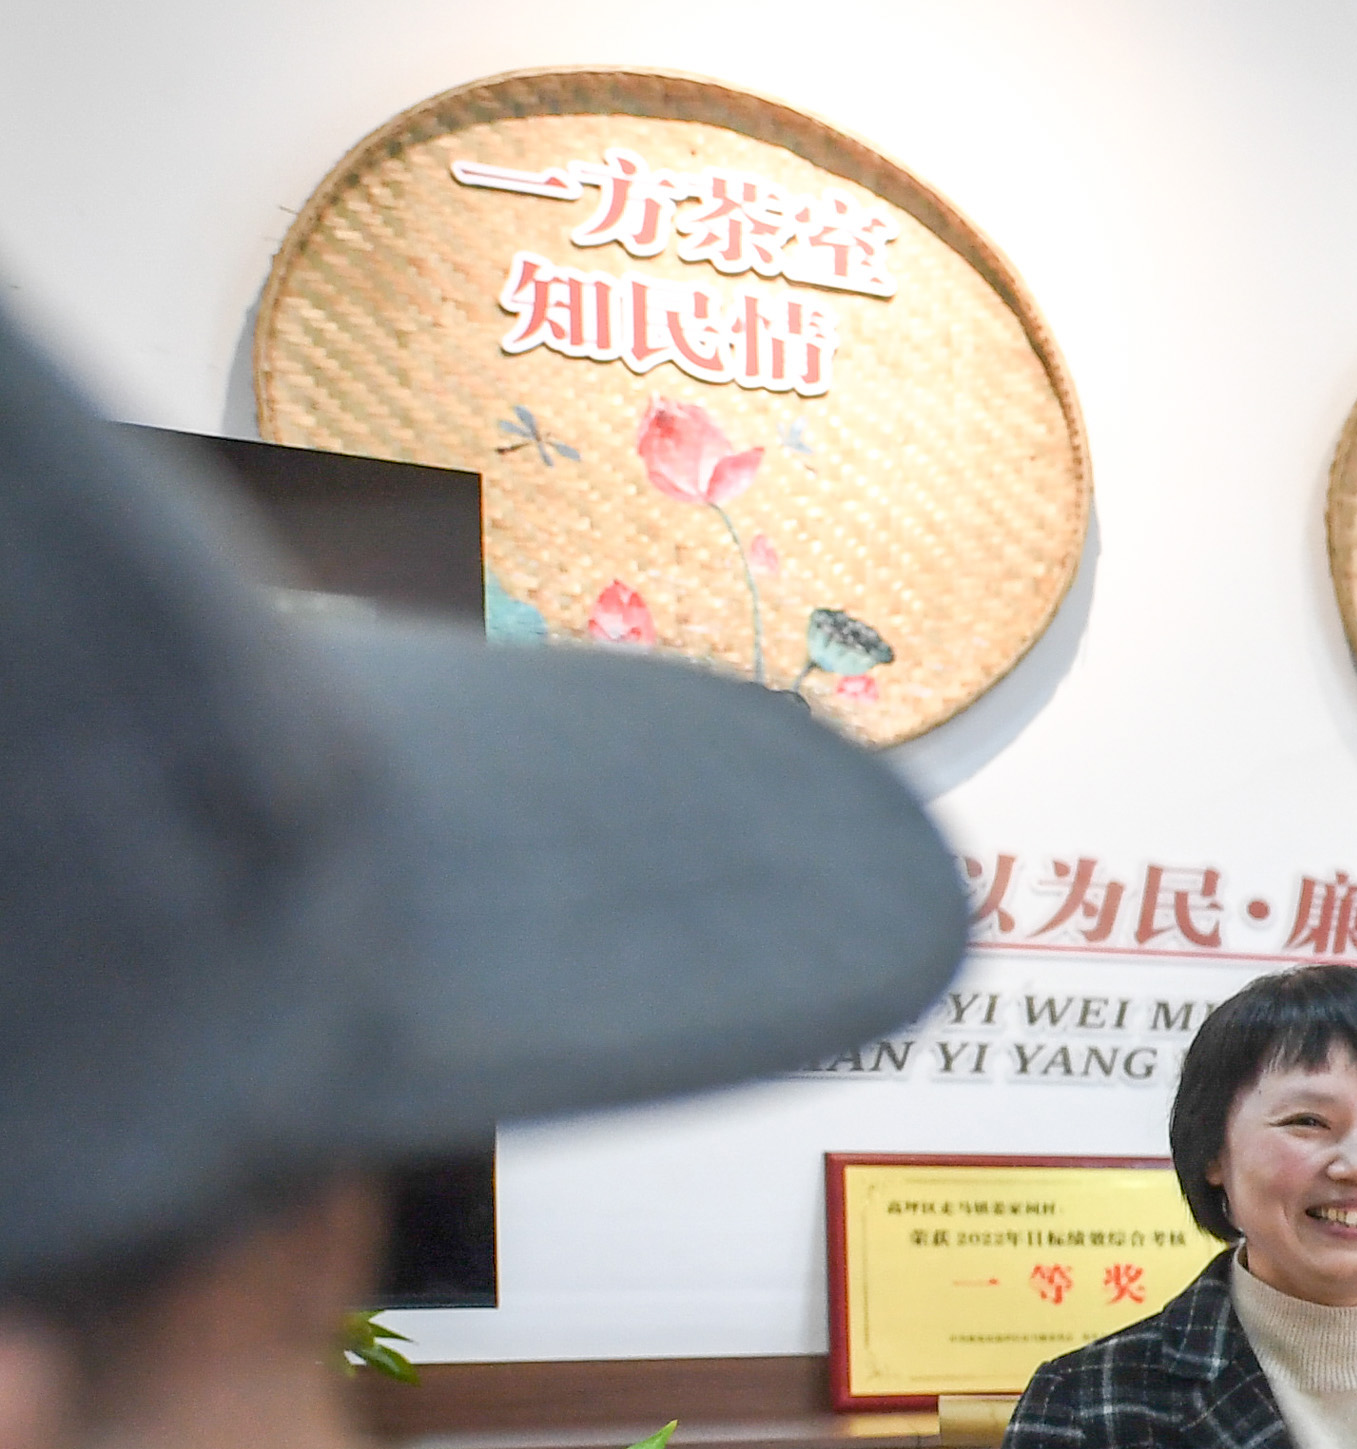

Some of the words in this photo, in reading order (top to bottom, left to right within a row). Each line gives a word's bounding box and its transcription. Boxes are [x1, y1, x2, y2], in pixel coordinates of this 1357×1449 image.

[453, 148, 896, 297] 一方茶室
[501, 254, 838, 396] 知民情
[948, 992, 998, 1023] YI
[1024, 994, 1132, 1029] WEI
[1149, 1001, 1214, 1032] M
[802, 1039, 914, 1072] AN
[936, 1040, 988, 1074] YI
[1013, 1043, 1158, 1079] YANG
[953, 1262, 1147, 1306] 一等奖
